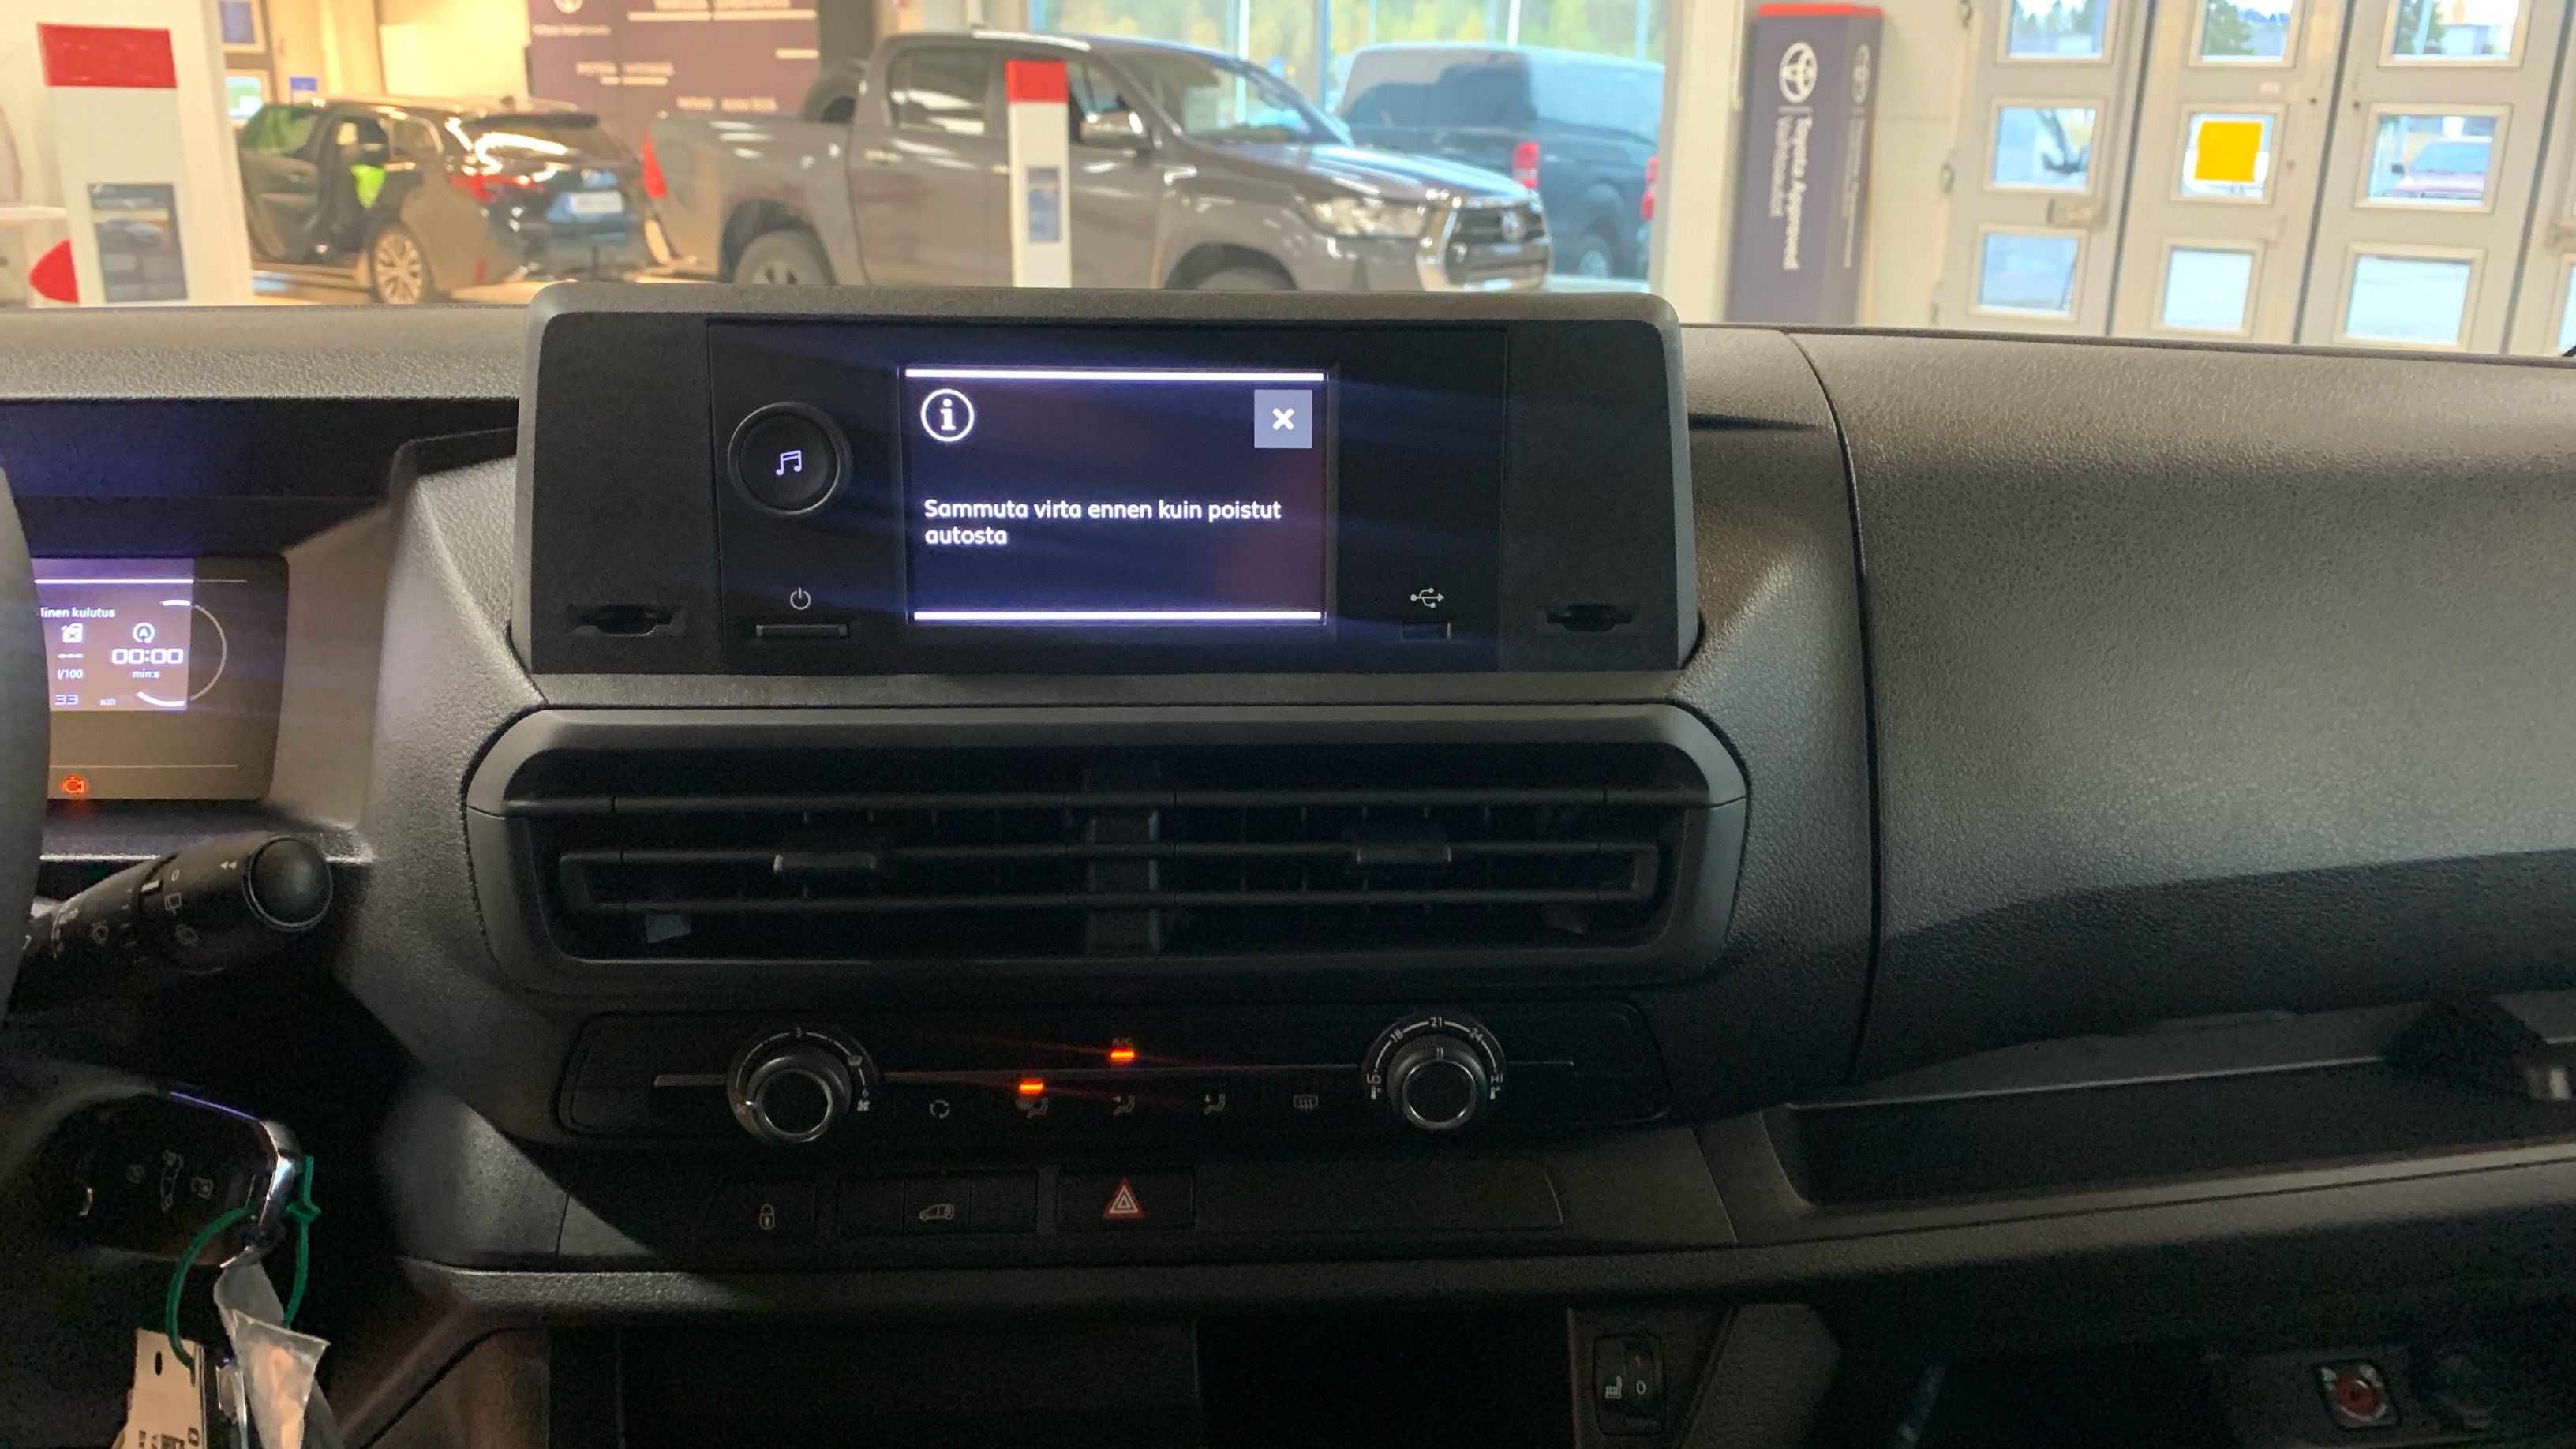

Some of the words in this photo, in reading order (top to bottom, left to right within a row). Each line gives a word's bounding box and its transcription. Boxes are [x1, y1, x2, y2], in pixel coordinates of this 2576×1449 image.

[924, 499, 1028, 518] Sammuta
[1034, 500, 1081, 518] virta
[1088, 503, 1152, 518] ennen
[1159, 499, 1202, 518] kuin
[1208, 500, 1282, 522] poistut
[925, 526, 1007, 544] autosta
[72, 607, 116, 618] kulutus
[111, 648, 183, 664] 00:00
[1430, 1017, 1443, 1028] 21
[1390, 1028, 1404, 1043] 18
[1470, 1028, 1484, 1043] 24
[1366, 1073, 1381, 1085] LO
[1490, 1073, 1503, 1084] HI
